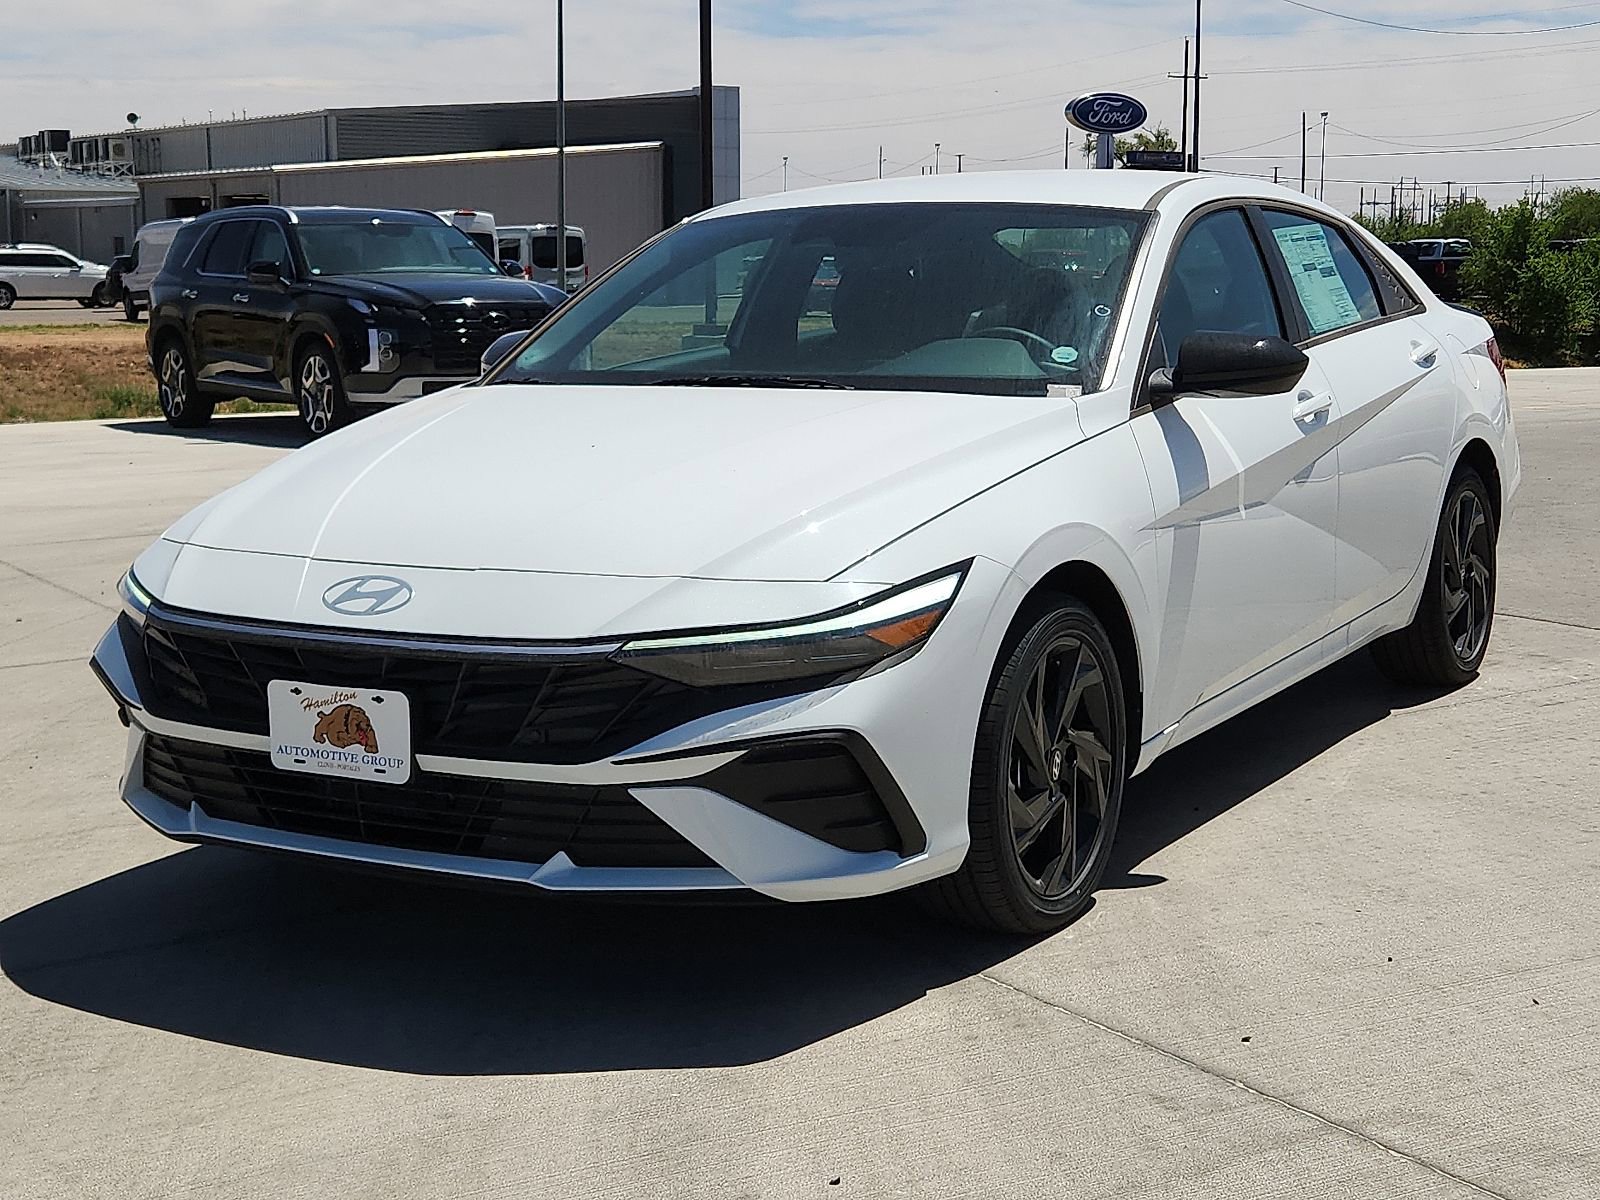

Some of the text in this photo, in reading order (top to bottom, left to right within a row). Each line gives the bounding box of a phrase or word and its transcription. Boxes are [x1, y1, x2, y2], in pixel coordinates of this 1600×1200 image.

[1088, 99, 1133, 125] Ford
[300, 691, 358, 712] Hamilton
[276, 745, 404, 769] AUTOMOTIVE GROUP
